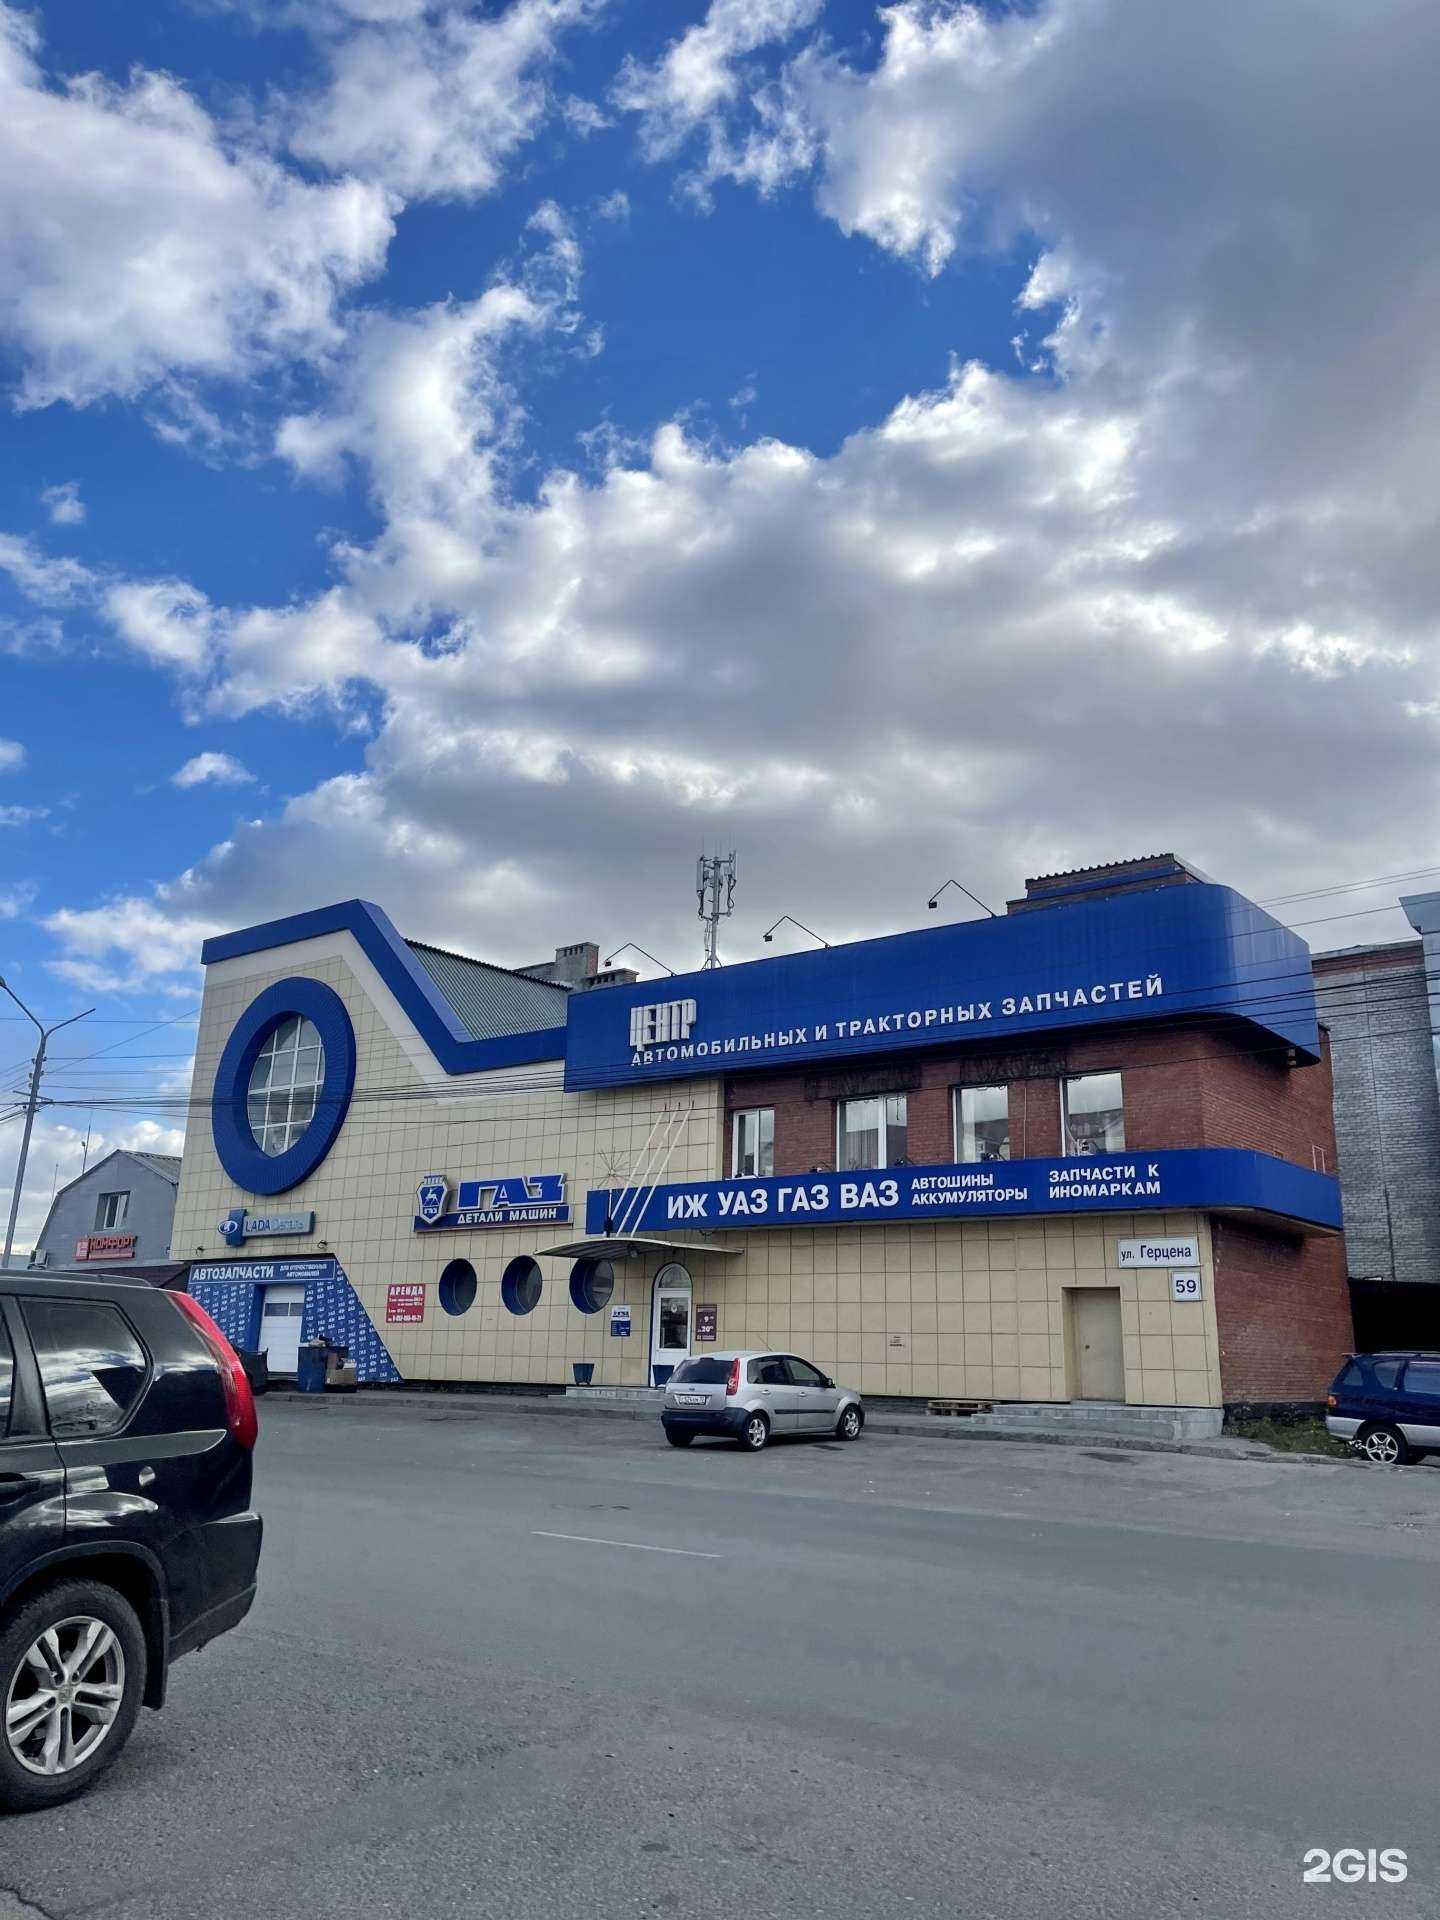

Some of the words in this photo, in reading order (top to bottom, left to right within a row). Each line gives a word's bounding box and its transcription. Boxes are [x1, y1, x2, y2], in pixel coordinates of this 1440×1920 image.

[630, 998, 696, 1051] ЦЕНТР
[631, 1027, 808, 1066] АВТОМОБИЛЬНЫХ
[815, 1025, 828, 1041] И
[835, 1002, 992, 1039] ТРАКТОРНЫХ
[1001, 973, 1163, 1016] ЗАПЧАСТЕЙ
[911, 1174, 994, 1190] АВТОШИНЫ
[1049, 1165, 1136, 1183] ЗАПЧАСТИ
[1148, 1163, 1160, 1177] К
[457, 1173, 565, 1210] ГАЗ
[911, 1187, 1028, 1206] АККУМУЛЯТОРЫ
[1049, 1181, 1161, 1199] ИНОМАРКАМ
[667, 1193, 708, 1219] ИЖ
[718, 1188, 768, 1216] УАЗ
[777, 1184, 829, 1213] ГАЗ
[840, 1180, 899, 1209] ВАЗ
[246, 1219, 271, 1232] LADA
[457, 1211, 503, 1225] ДЕТАЛИ
[509, 1208, 557, 1221] МАШИН
[1121, 1250, 1135, 1262] ул.
[1140, 1244, 1192, 1261] Герцена
[191, 1265, 275, 1281] АВТОЗАПЧАСТИ
[390, 1286, 423, 1296] АРЕНДА
[1175, 1279, 1197, 1294] 59
